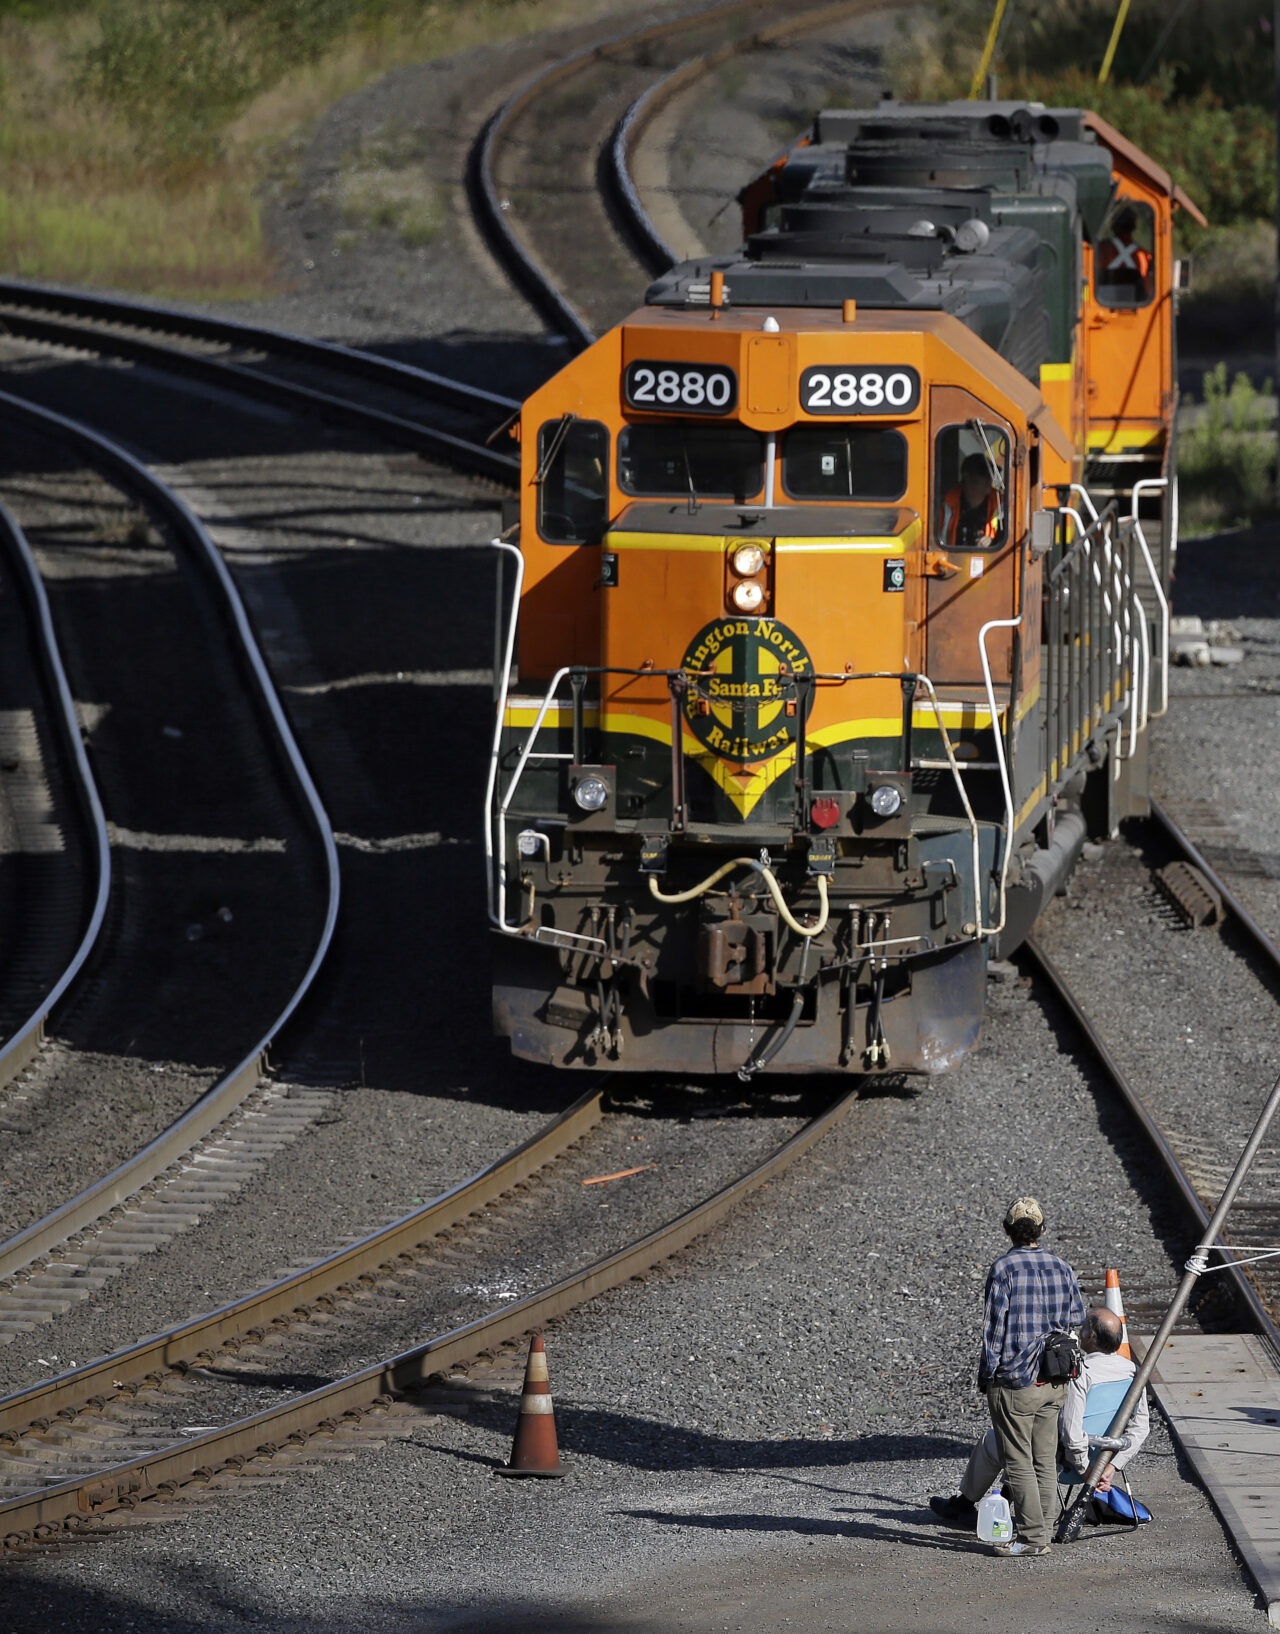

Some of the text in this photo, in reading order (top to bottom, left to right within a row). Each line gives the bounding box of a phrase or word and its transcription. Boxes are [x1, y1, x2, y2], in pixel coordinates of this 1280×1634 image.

[633, 369, 731, 406] 2880
[807, 373, 912, 407] 2880
[708, 678, 782, 697] Santa Fe
[705, 725, 790, 758] Railway
